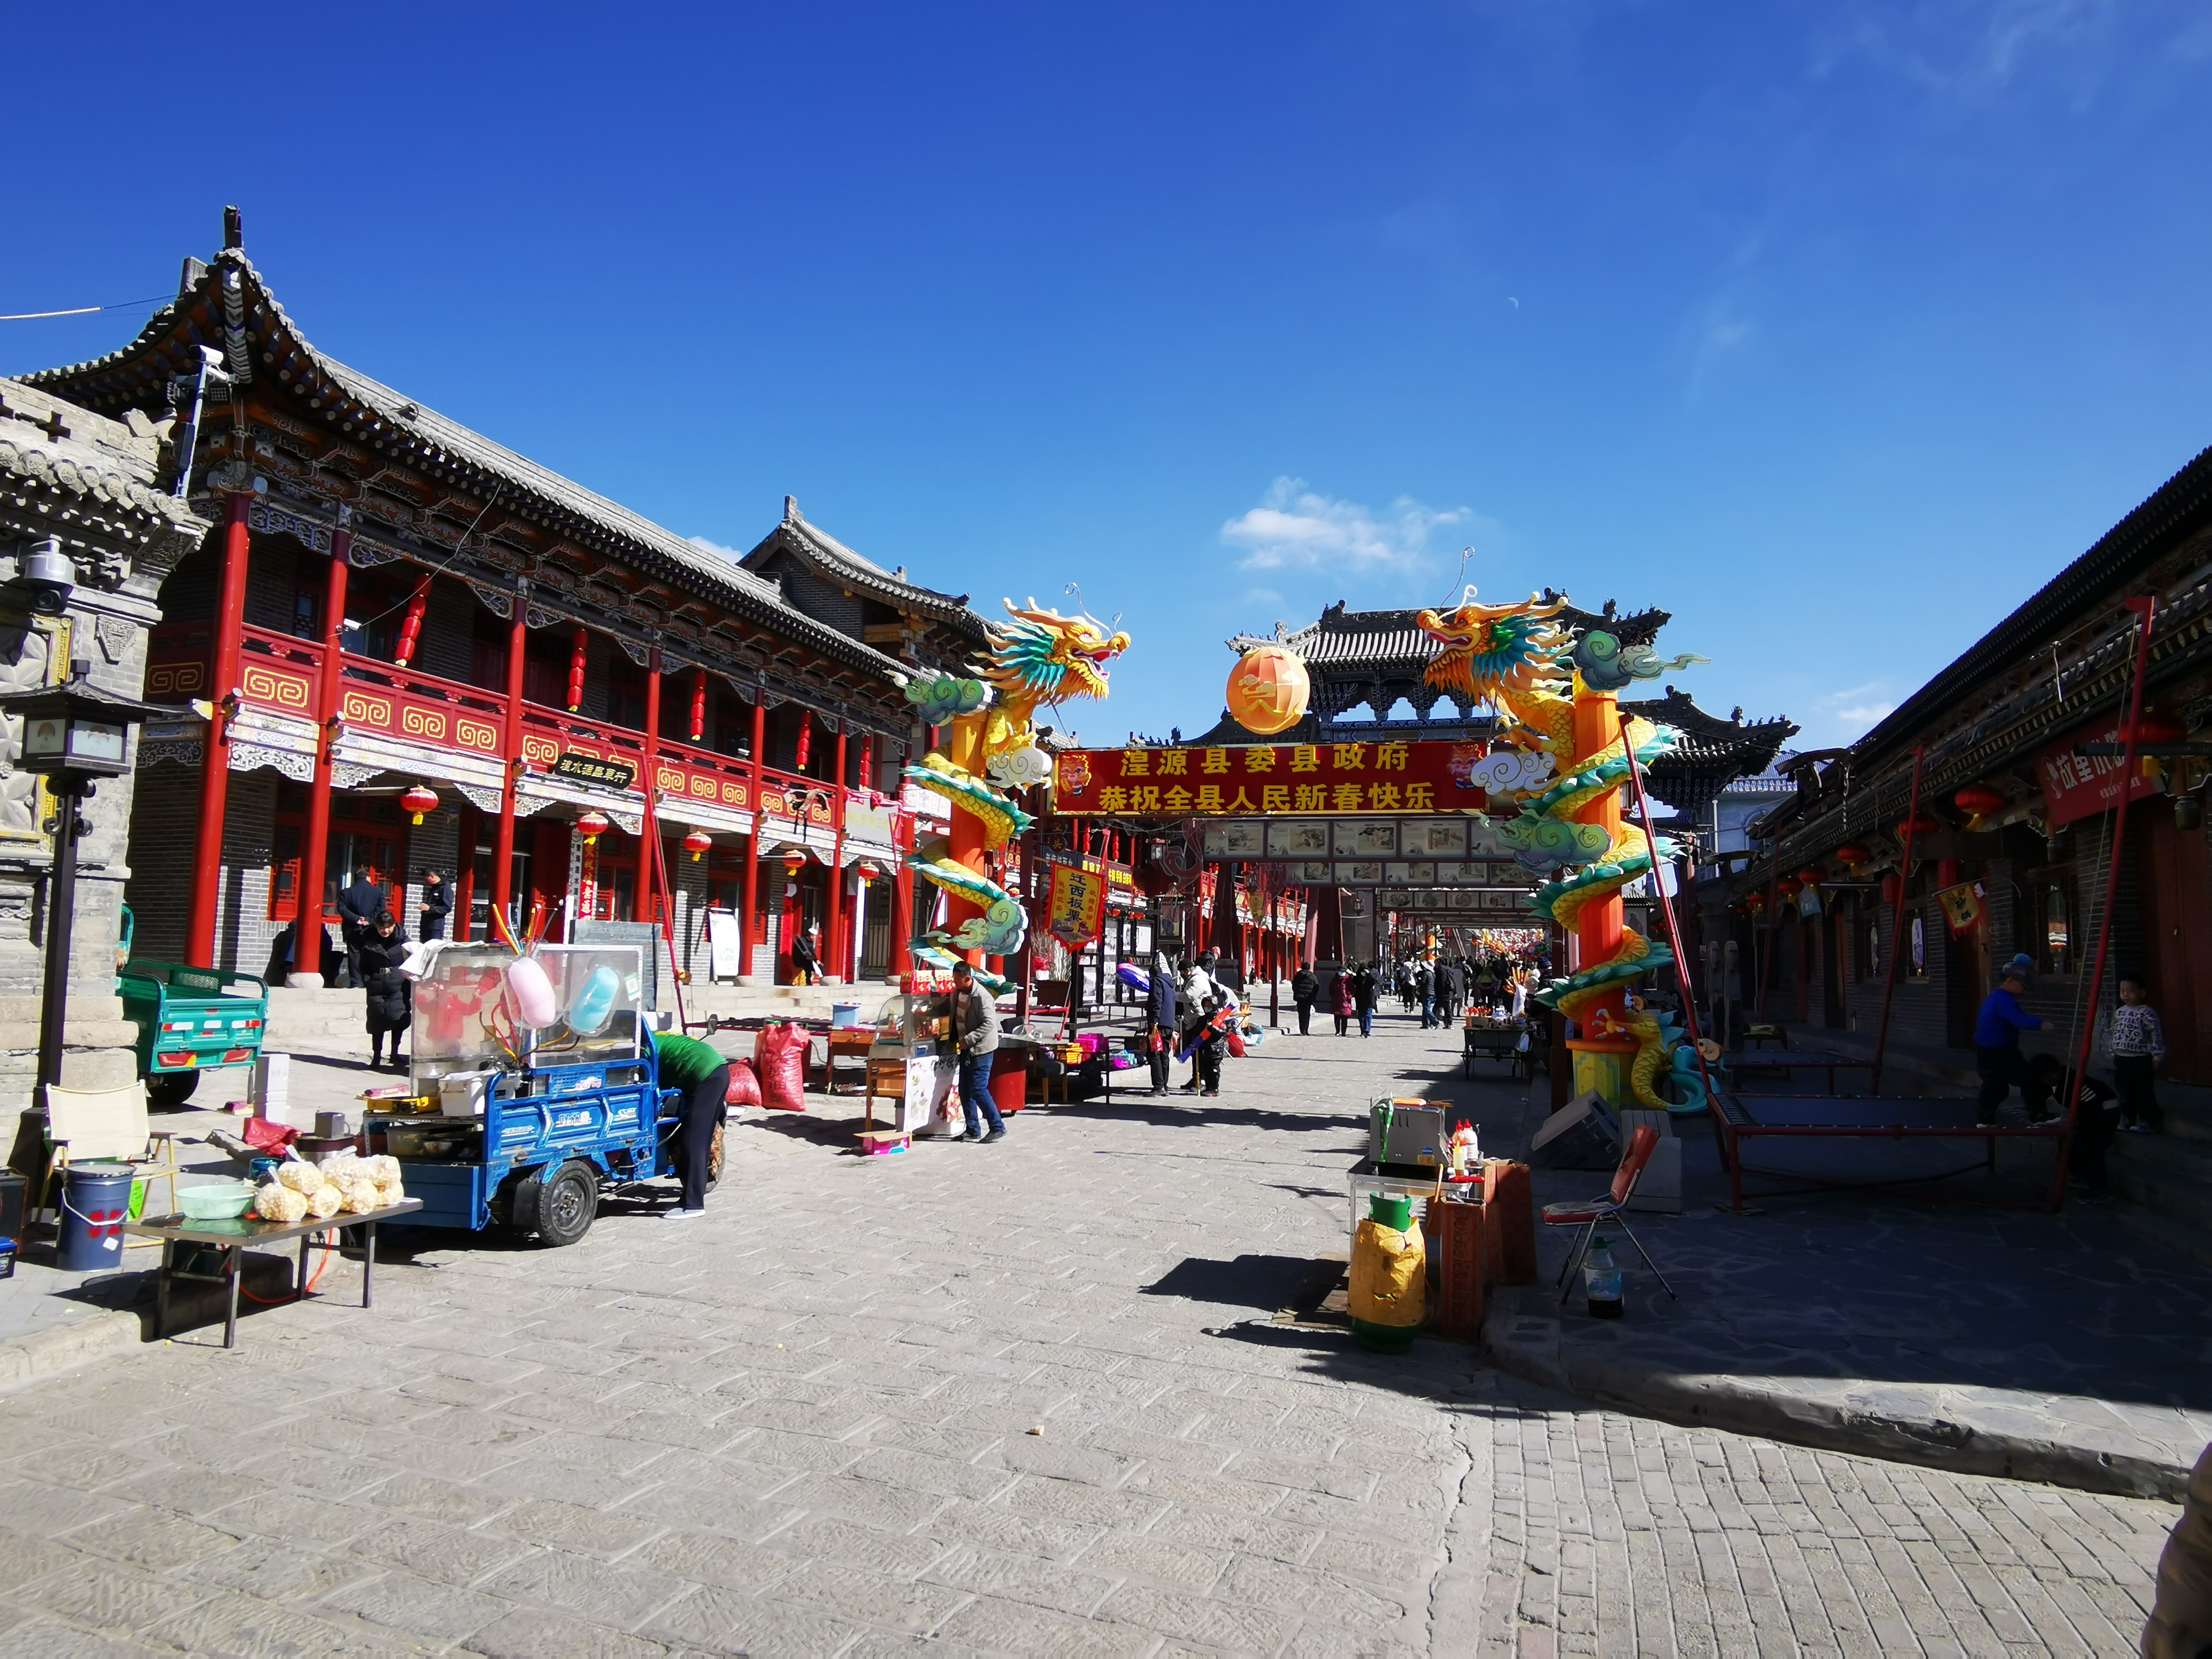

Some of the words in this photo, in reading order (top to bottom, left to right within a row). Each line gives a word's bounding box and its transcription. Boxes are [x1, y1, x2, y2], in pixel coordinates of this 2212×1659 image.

[1120, 744, 1409, 777] 湟源县委县政府
[1099, 781, 1435, 812] 恭祝全县人民新春快乐
[1066, 872, 1087, 922] 迁西板栗
